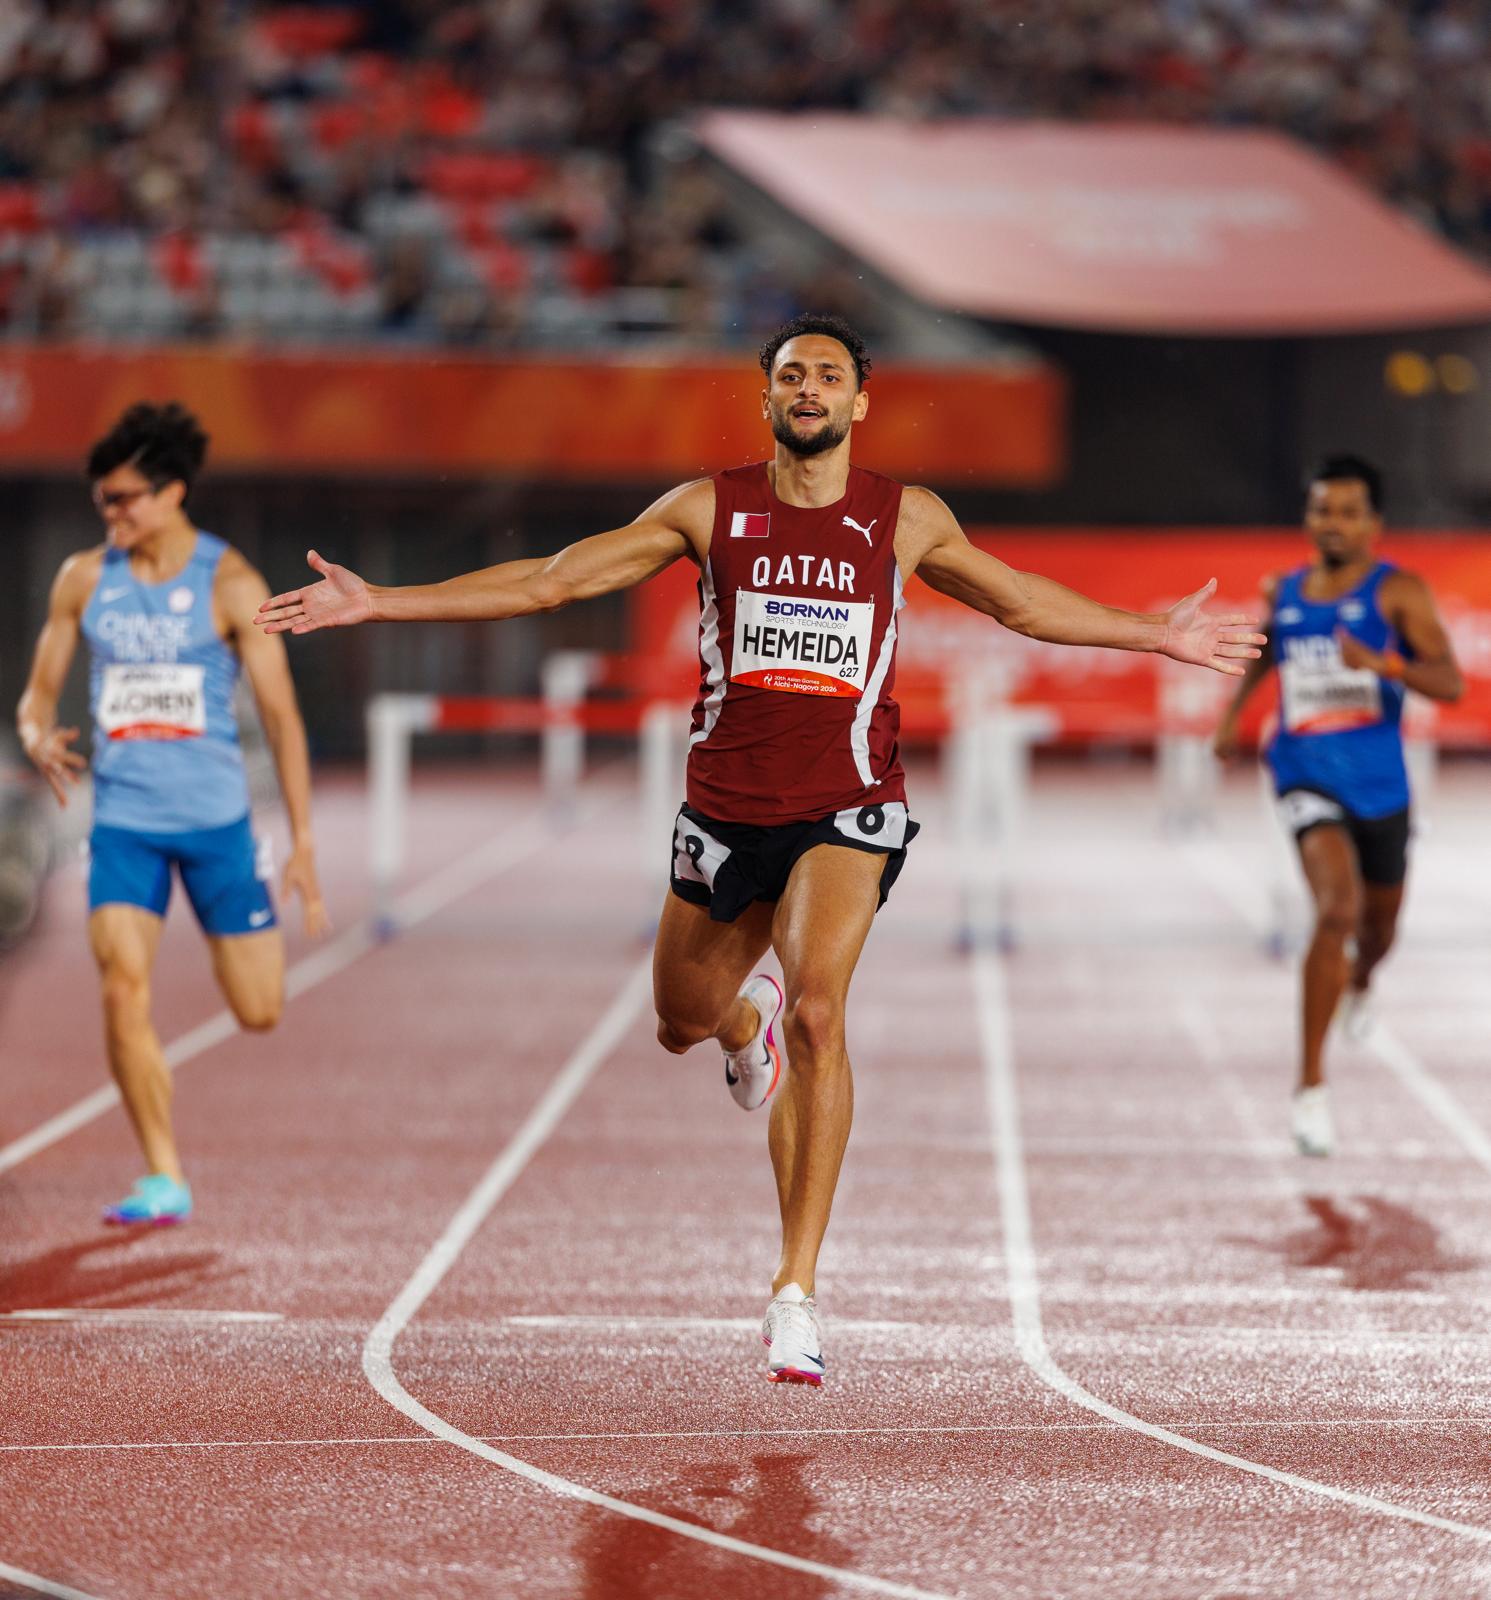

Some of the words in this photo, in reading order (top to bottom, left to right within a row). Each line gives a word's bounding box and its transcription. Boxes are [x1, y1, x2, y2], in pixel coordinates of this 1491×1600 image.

[752, 555, 856, 594] QATAR
[764, 600, 849, 621] BORNAN
[765, 616, 795, 625] SPORTS
[797, 618, 848, 630] TECHNOLOGY
[742, 623, 859, 665] HEMEIDA
[839, 667, 859, 678] 627
[773, 680, 819, 692] Aichi-Nagoya
[820, 685, 837, 693] 2026
